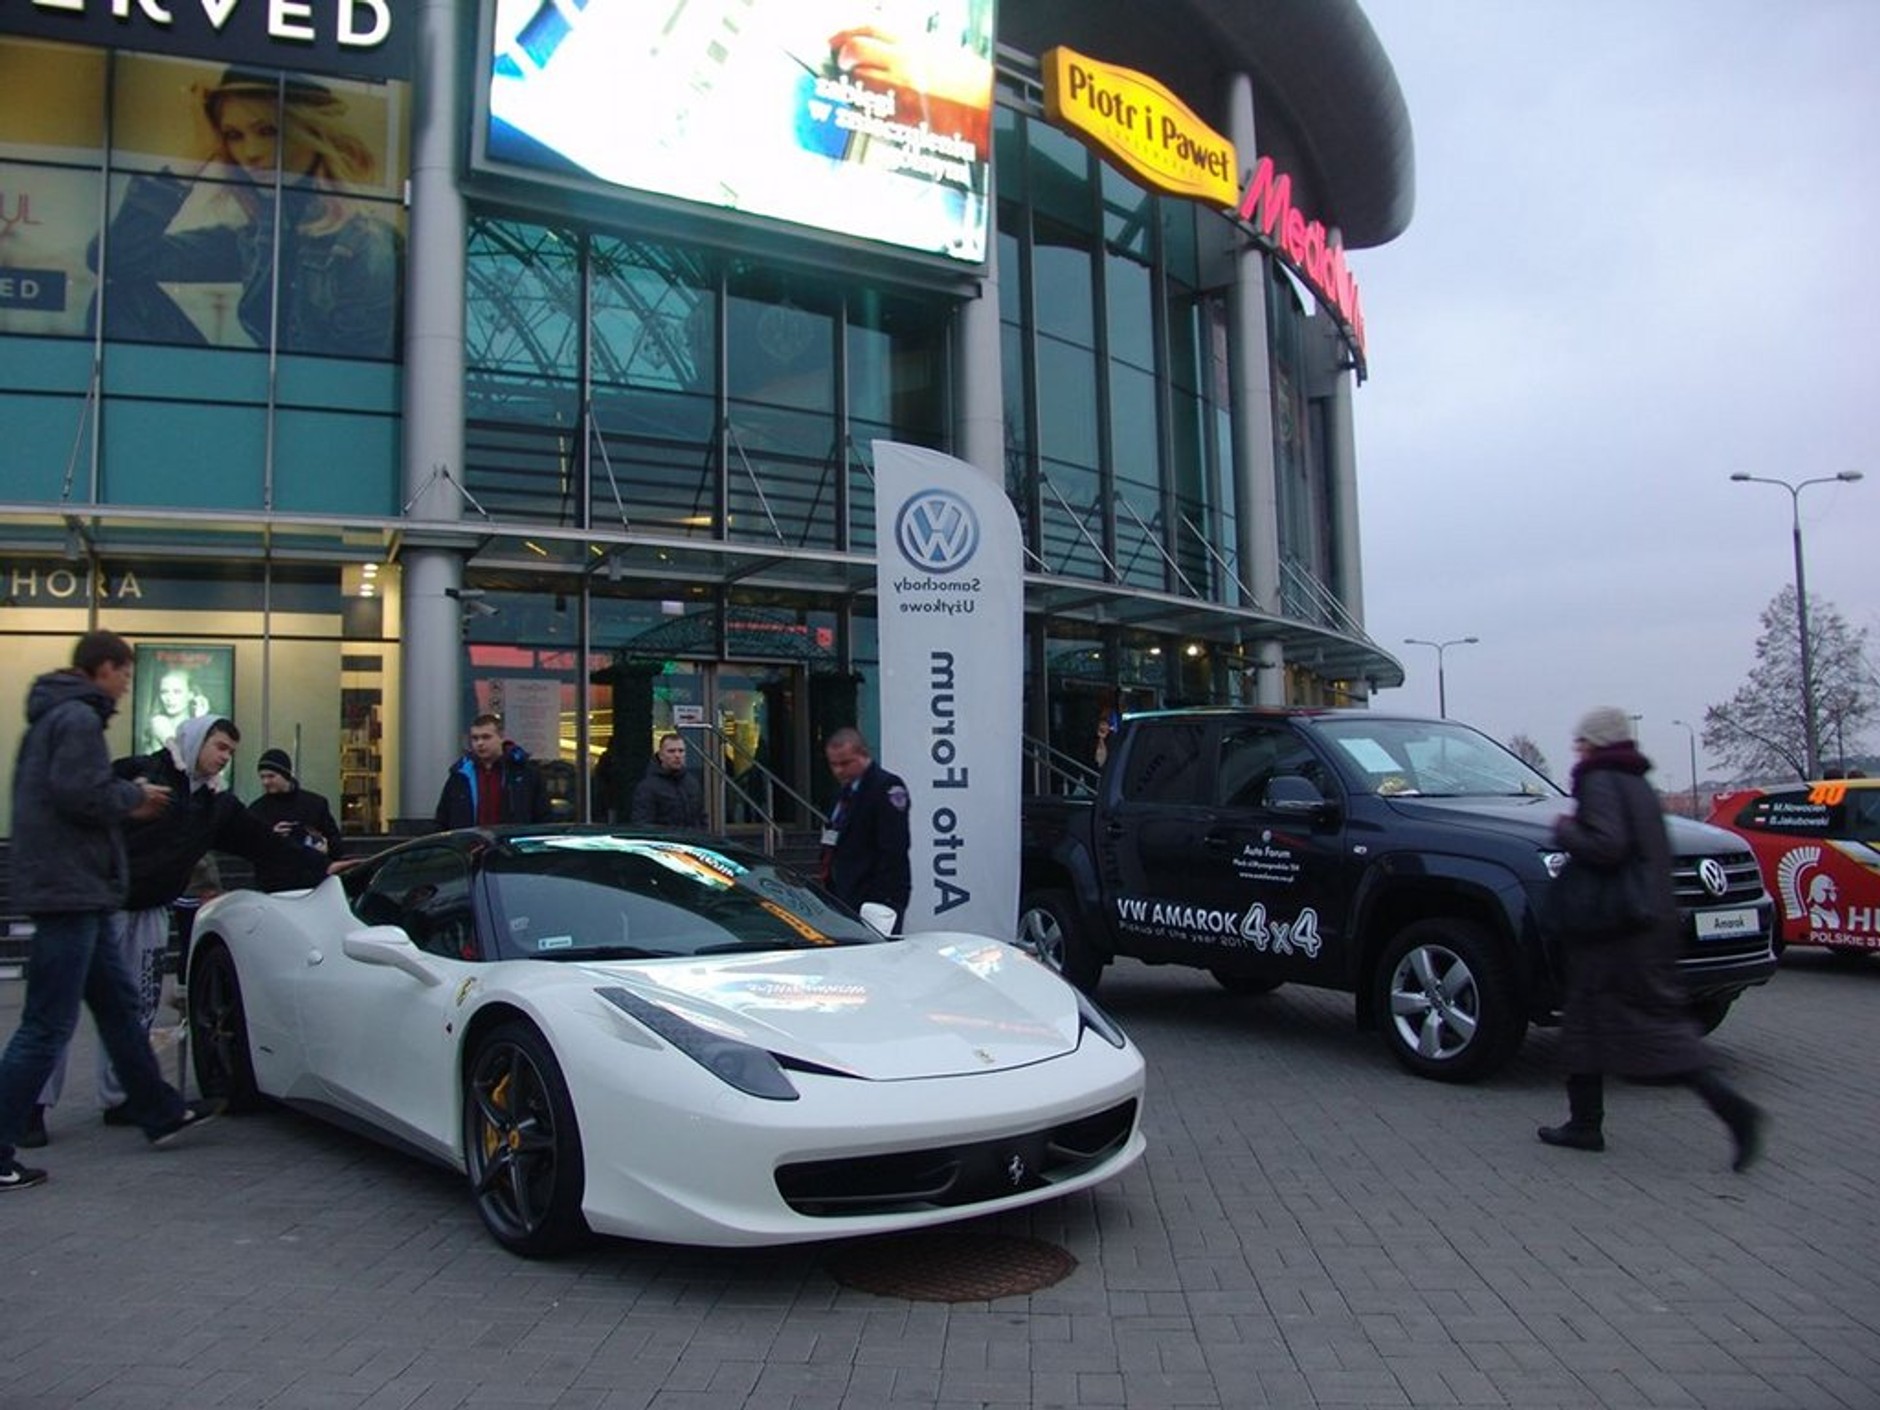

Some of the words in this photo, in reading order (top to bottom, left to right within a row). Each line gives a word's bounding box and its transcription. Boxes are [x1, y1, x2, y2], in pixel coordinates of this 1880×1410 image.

[33, 0, 391, 46] VED
[1069, 63, 1137, 130] Piotr
[1144, 105, 1153, 141] i
[12, 568, 143, 599] HORA
[1117, 898, 1148, 922] VW
[1152, 903, 1238, 935] AMAROK
[1240, 902, 1323, 958] 4x4
[1713, 916, 1745, 930] Amarok
[1810, 931, 1864, 945] POLSKIE
